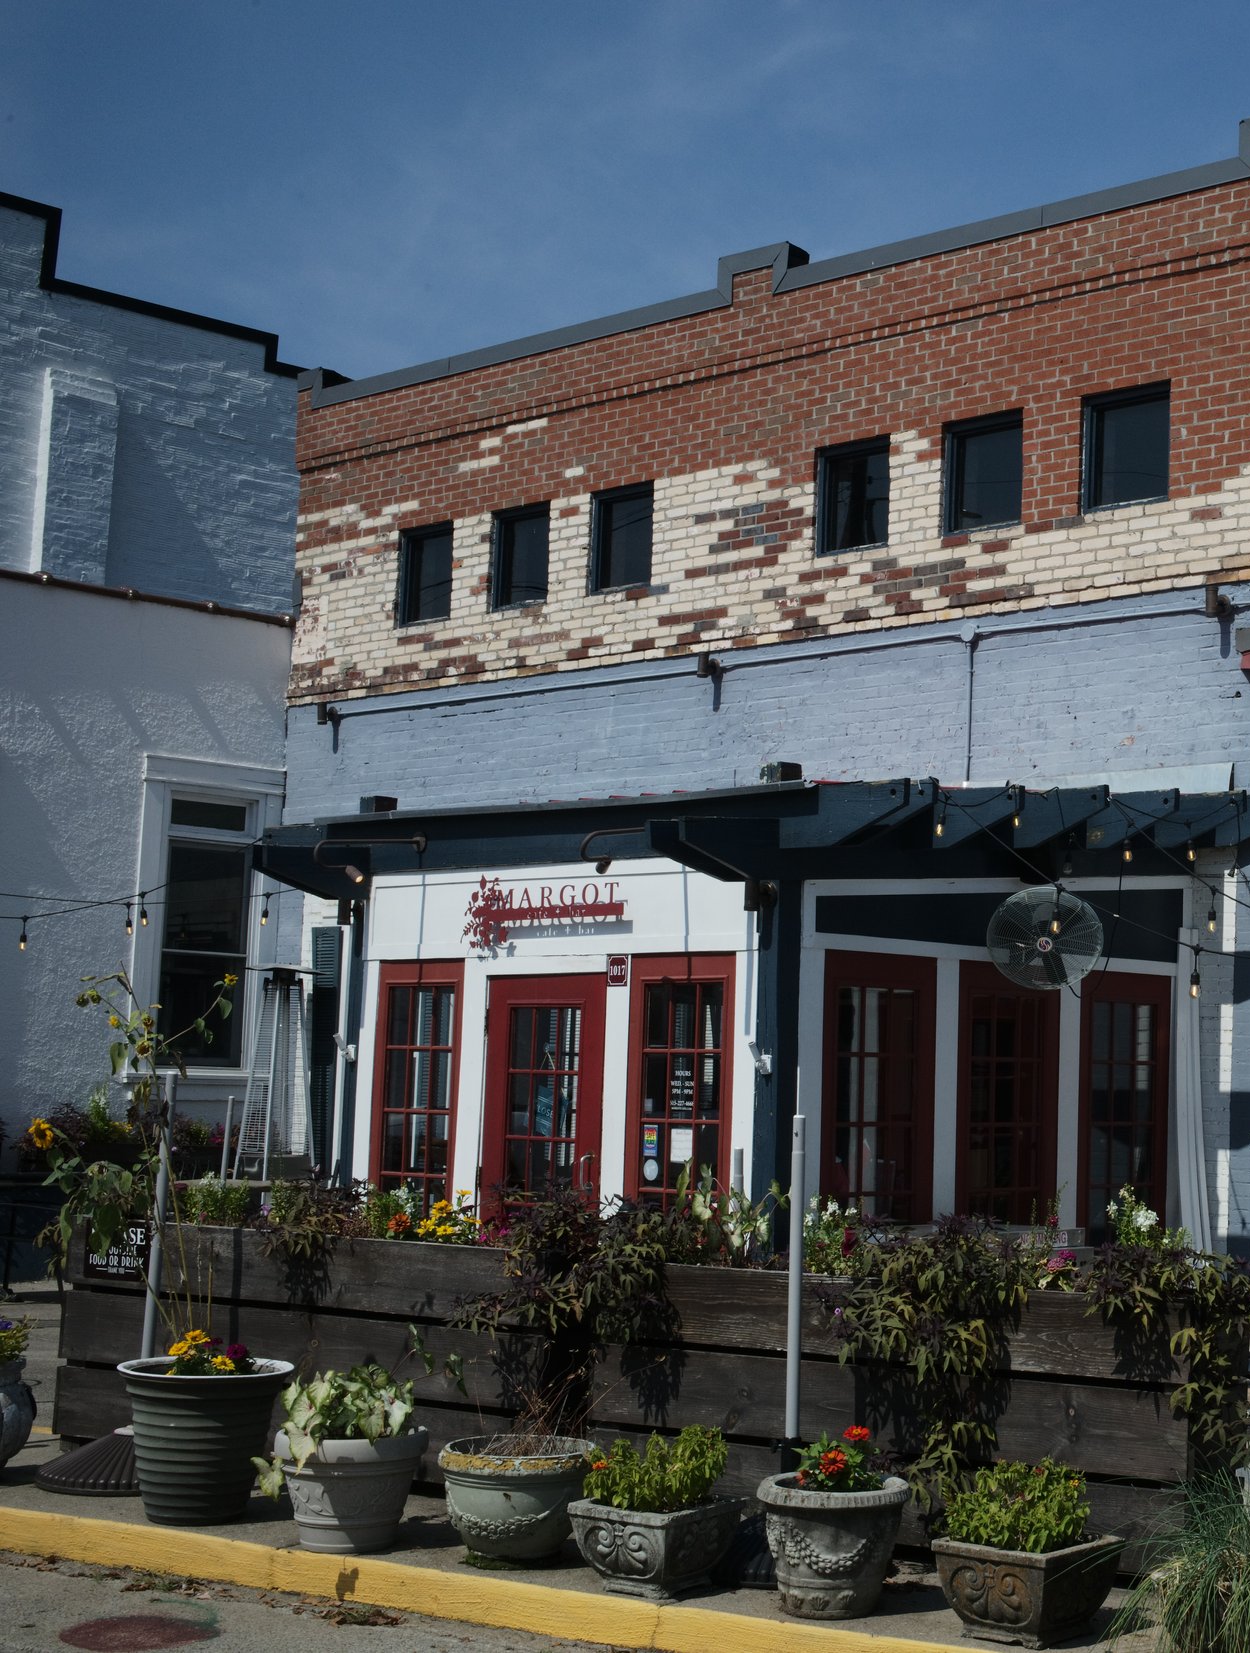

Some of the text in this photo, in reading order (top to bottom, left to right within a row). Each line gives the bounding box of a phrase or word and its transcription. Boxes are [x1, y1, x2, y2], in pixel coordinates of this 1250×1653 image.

[498, 882, 620, 909] MARGOT
[568, 906, 586, 917] bar
[610, 965, 626, 976] 1017
[109, 1255, 119, 1267] OR
[121, 1256, 144, 1268] DRINK
